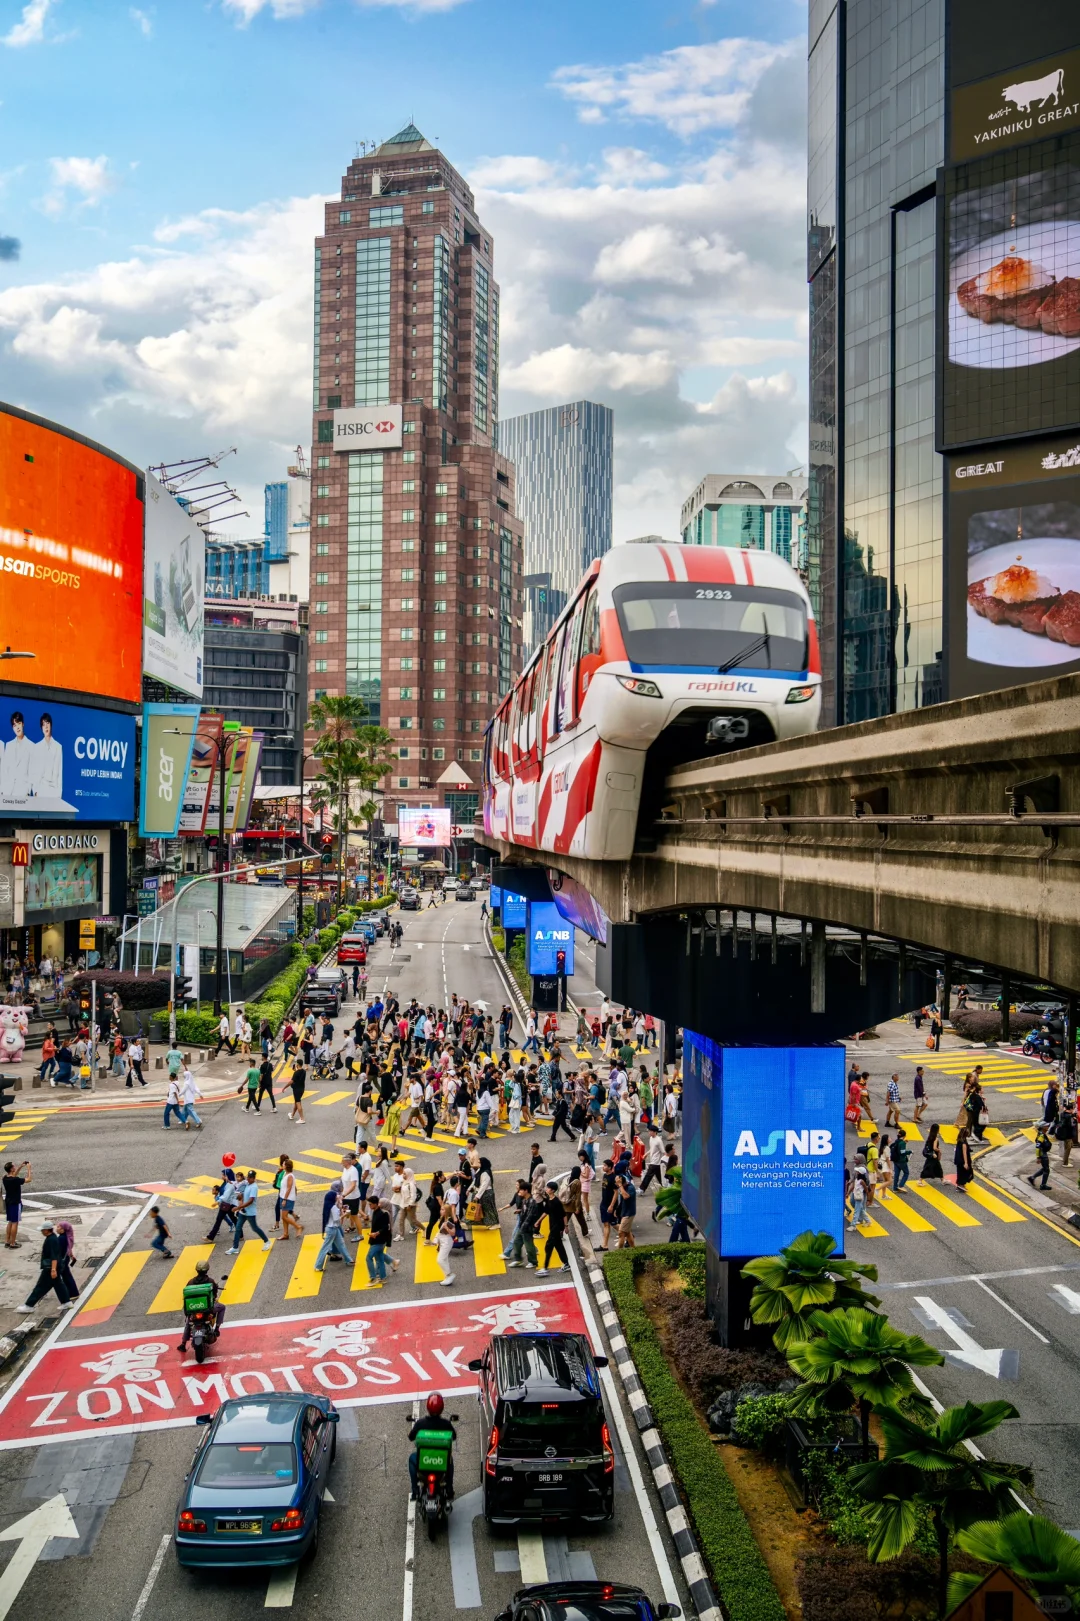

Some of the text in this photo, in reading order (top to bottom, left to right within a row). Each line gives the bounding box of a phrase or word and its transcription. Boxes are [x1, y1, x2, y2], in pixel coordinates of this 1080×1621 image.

[973, 117, 1033, 144] YAKINIKU
[1037, 102, 1080, 126] GREAT
[336, 412, 374, 437] HSBC
[955, 460, 1005, 479] GREAT
[695, 589, 733, 600] 2933
[687, 681, 758, 693] rapidKL
[80, 768, 97, 778] HIDUP
[158, 748, 174, 802] acer
[33, 834, 99, 851] GIORDANO
[506, 895, 527, 903] ASN
[534, 930, 570, 940] ASNB
[733, 1129, 833, 1156] ASNB
[732, 1161, 834, 1171] Mengukuh Kedudukan
[742, 1171, 824, 1180] Kewangan Rakyat,
[741, 1180, 825, 1189] Merentas Generasi.
[188, 1301, 205, 1310] Grab
[26, 1378, 175, 1427] ZON
[423, 1456, 444, 1465] Grab
[552, 1473, 563, 1481] 189
